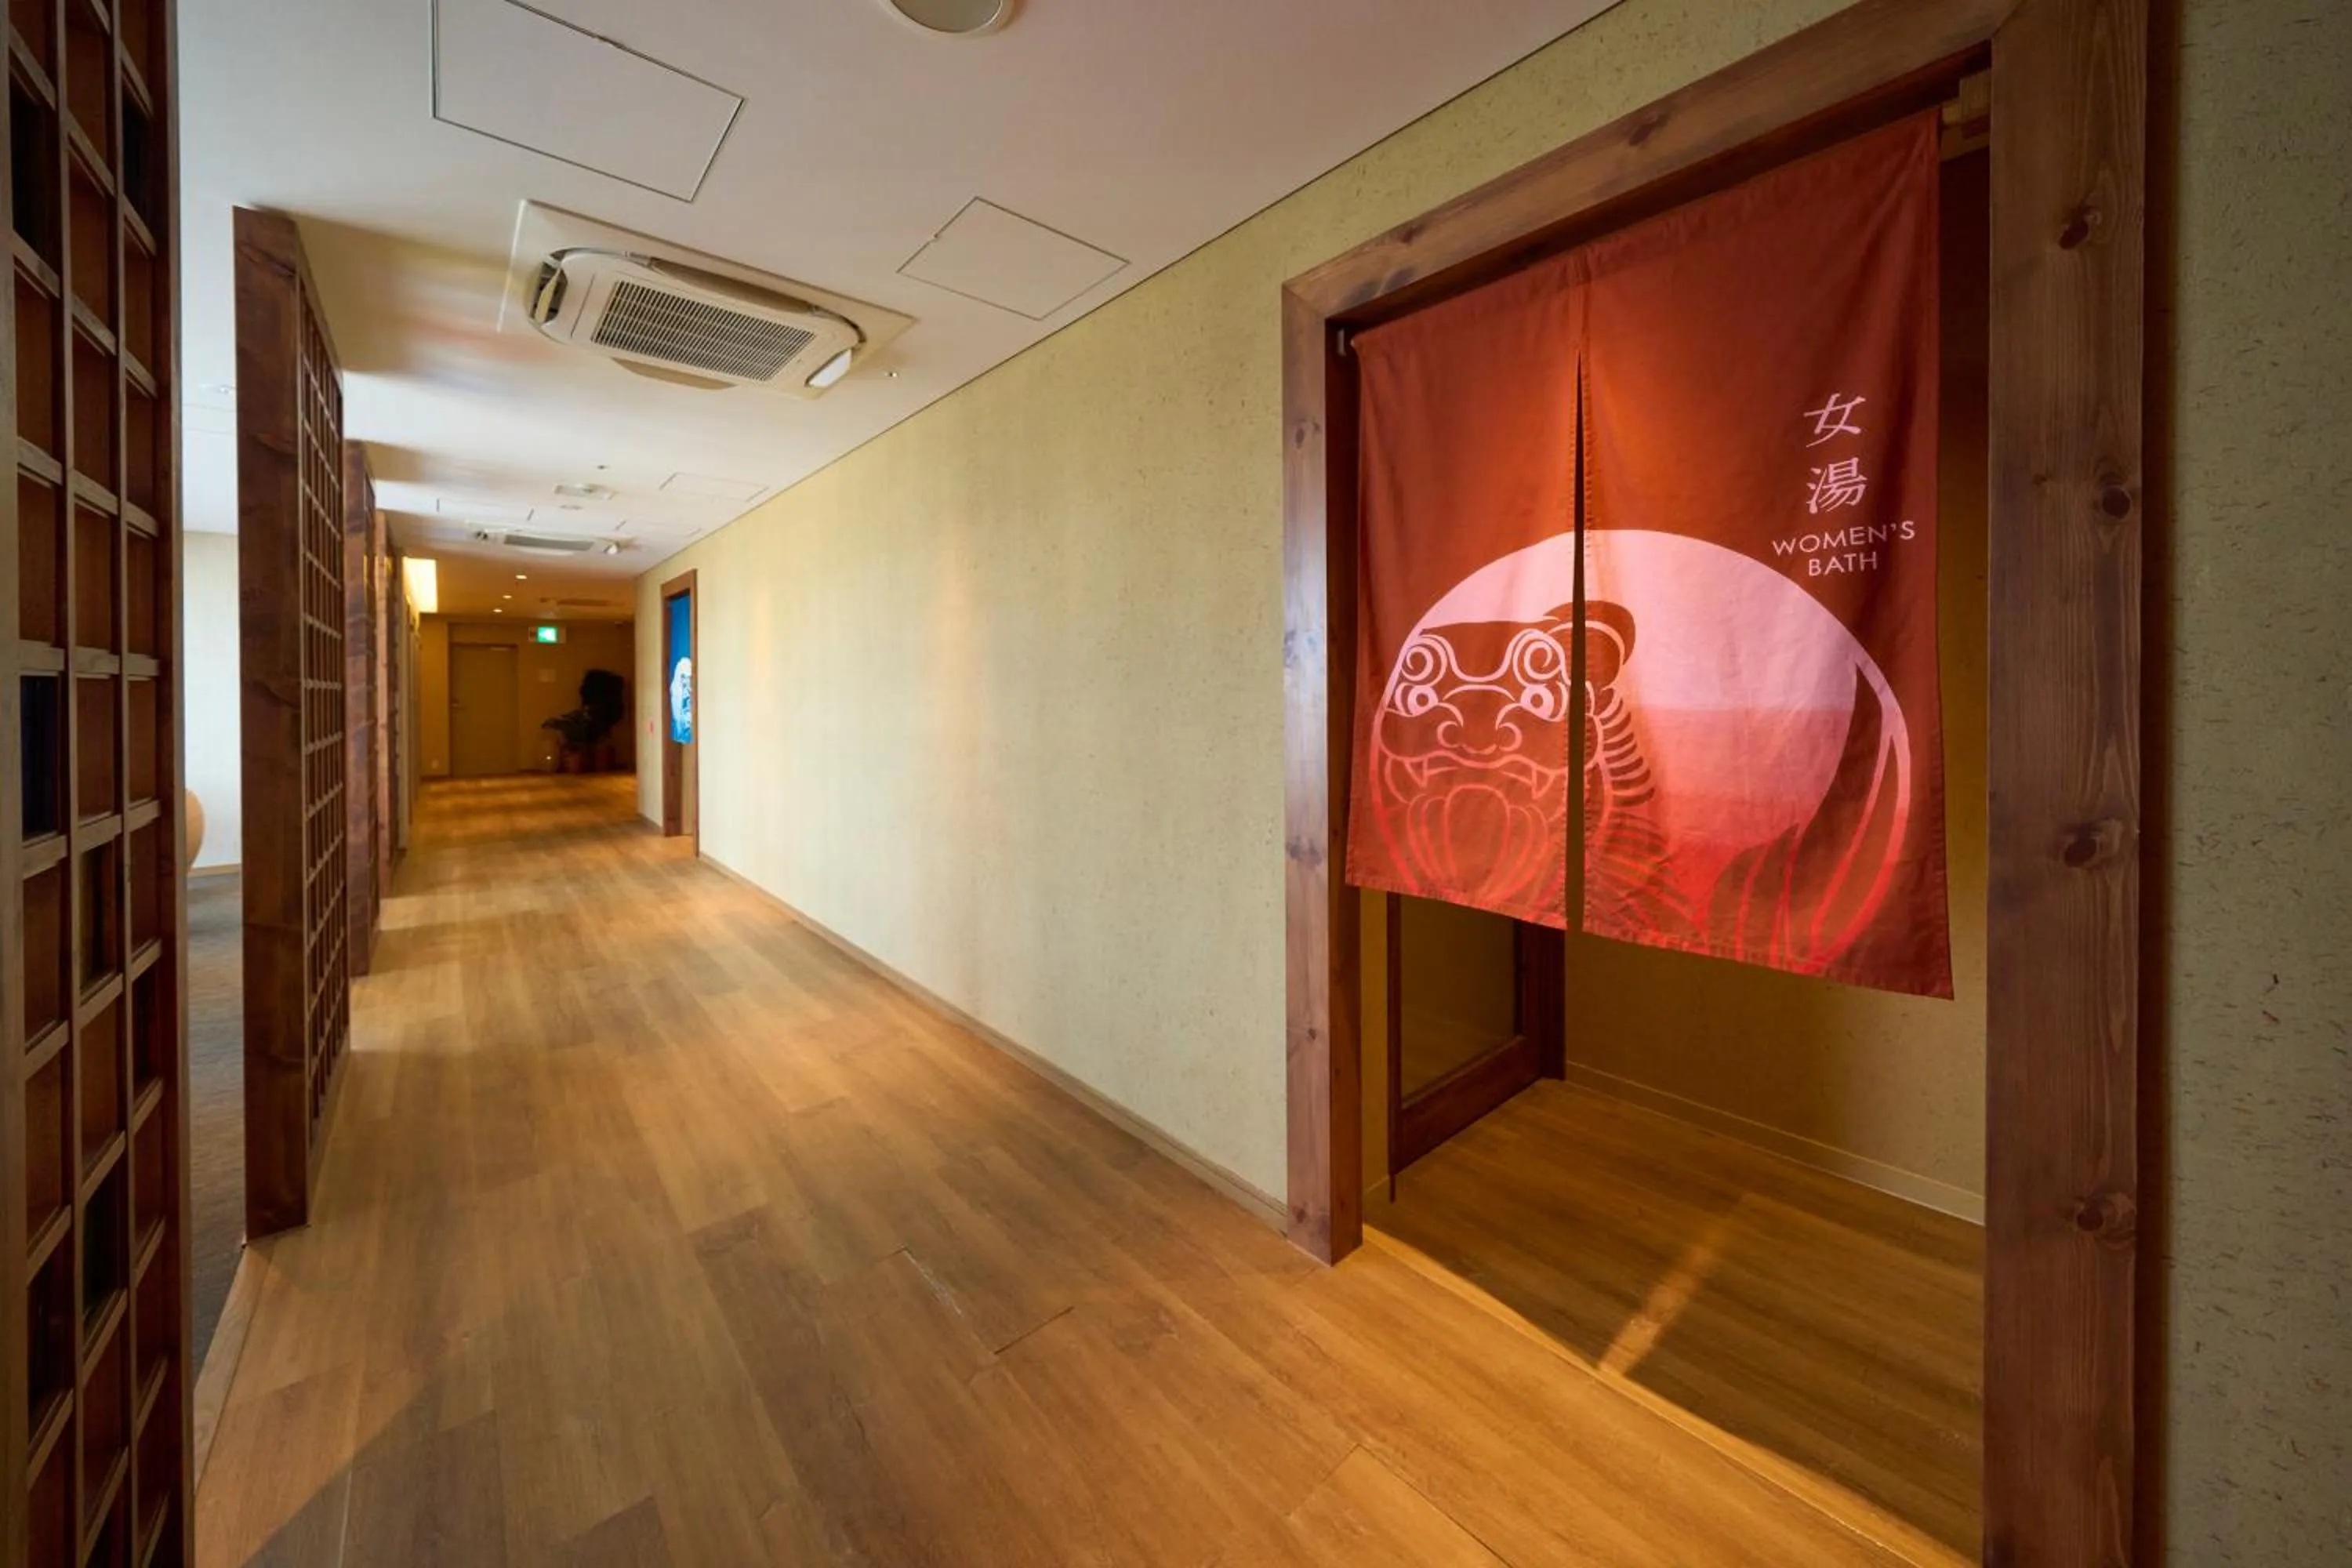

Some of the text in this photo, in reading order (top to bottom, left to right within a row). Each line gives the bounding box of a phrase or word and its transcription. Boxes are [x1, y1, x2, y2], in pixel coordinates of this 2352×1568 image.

[1804, 393, 1867, 514] 女湯
[1772, 521, 1915, 556] WOMEN'S
[1809, 551, 1877, 576] BATH
